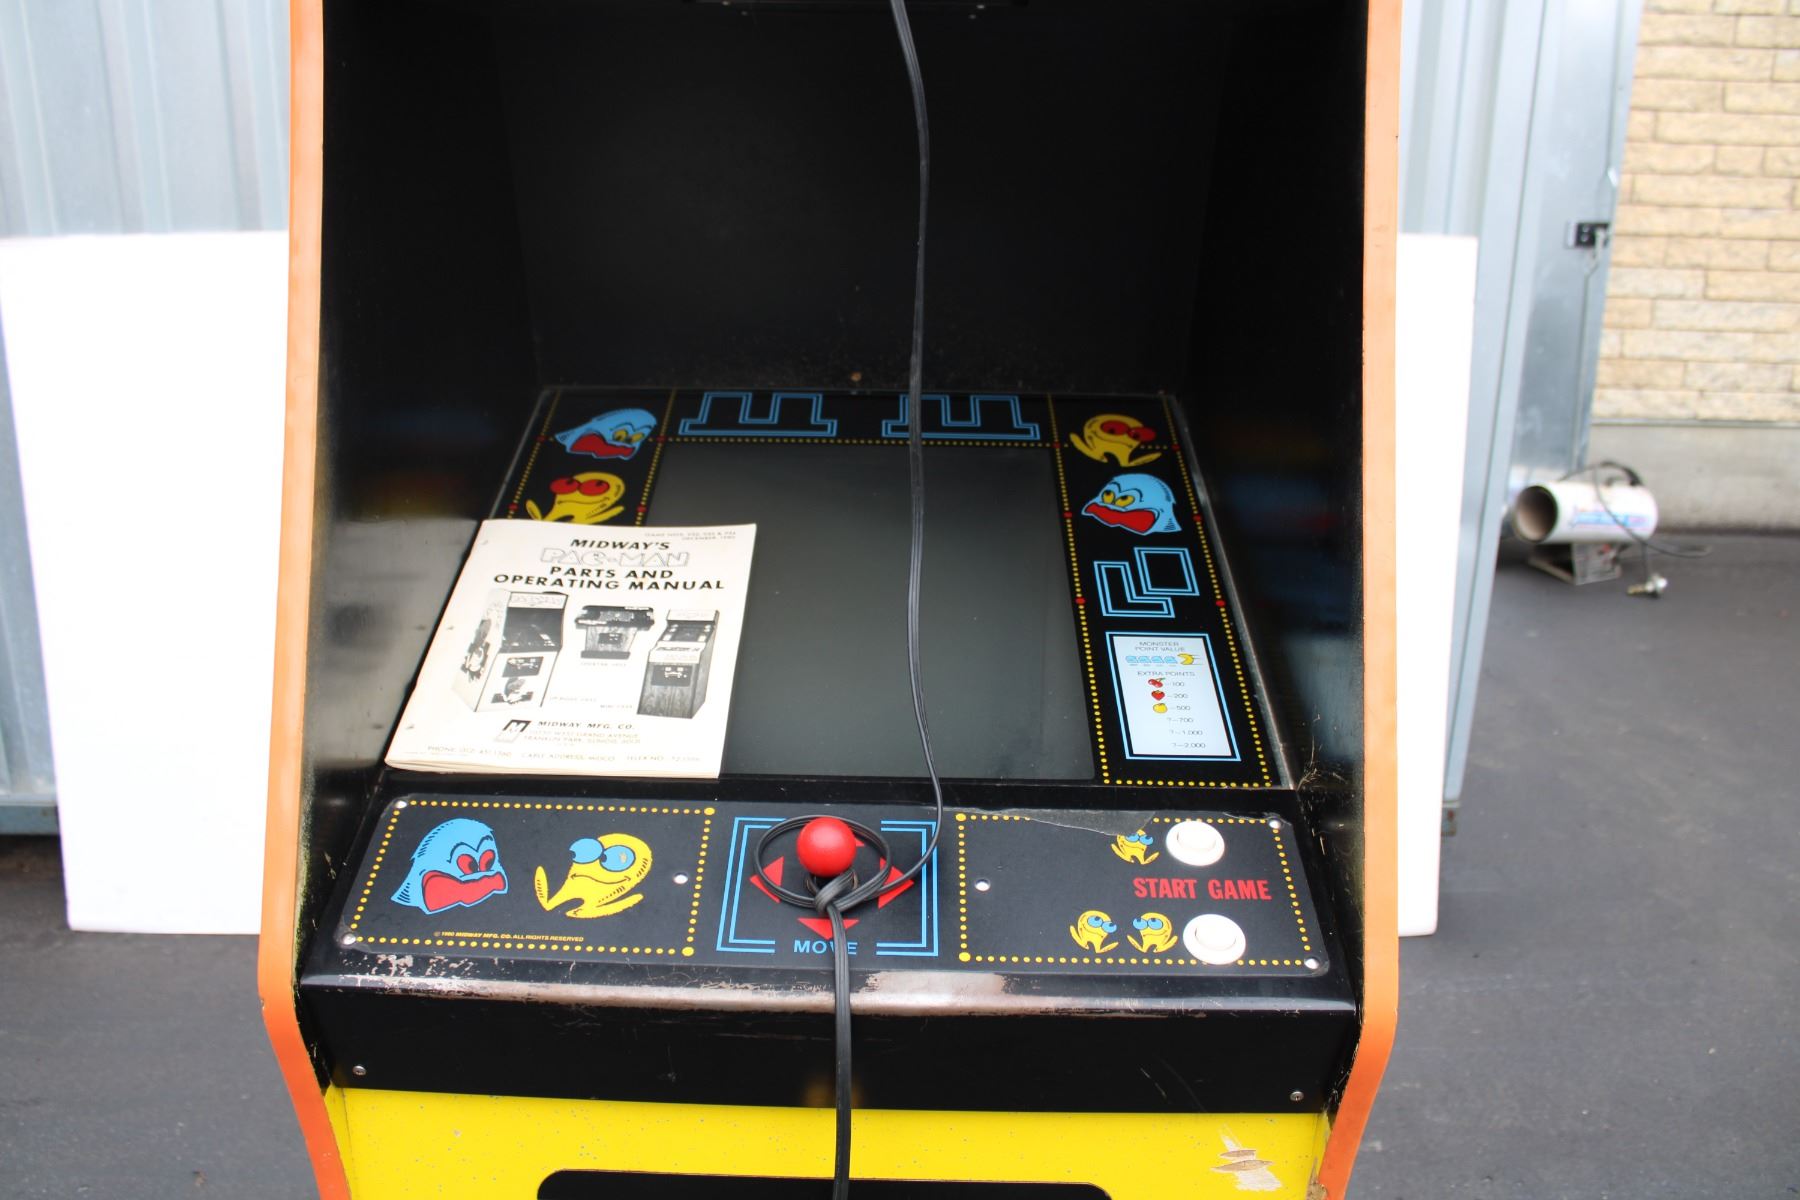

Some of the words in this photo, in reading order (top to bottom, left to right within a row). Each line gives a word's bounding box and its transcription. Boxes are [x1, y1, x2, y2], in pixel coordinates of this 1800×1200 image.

[570, 539, 670, 550] MIDWAY'S
[549, 566, 616, 578] PARTS
[625, 569, 674, 579] AND
[493, 574, 620, 590] OPERATING
[628, 580, 726, 590] MANUAL
[538, 720, 581, 729] MIDWAY
[1132, 877, 1197, 899] START
[1208, 879, 1272, 900] GAME
[793, 940, 858, 955] MOE
